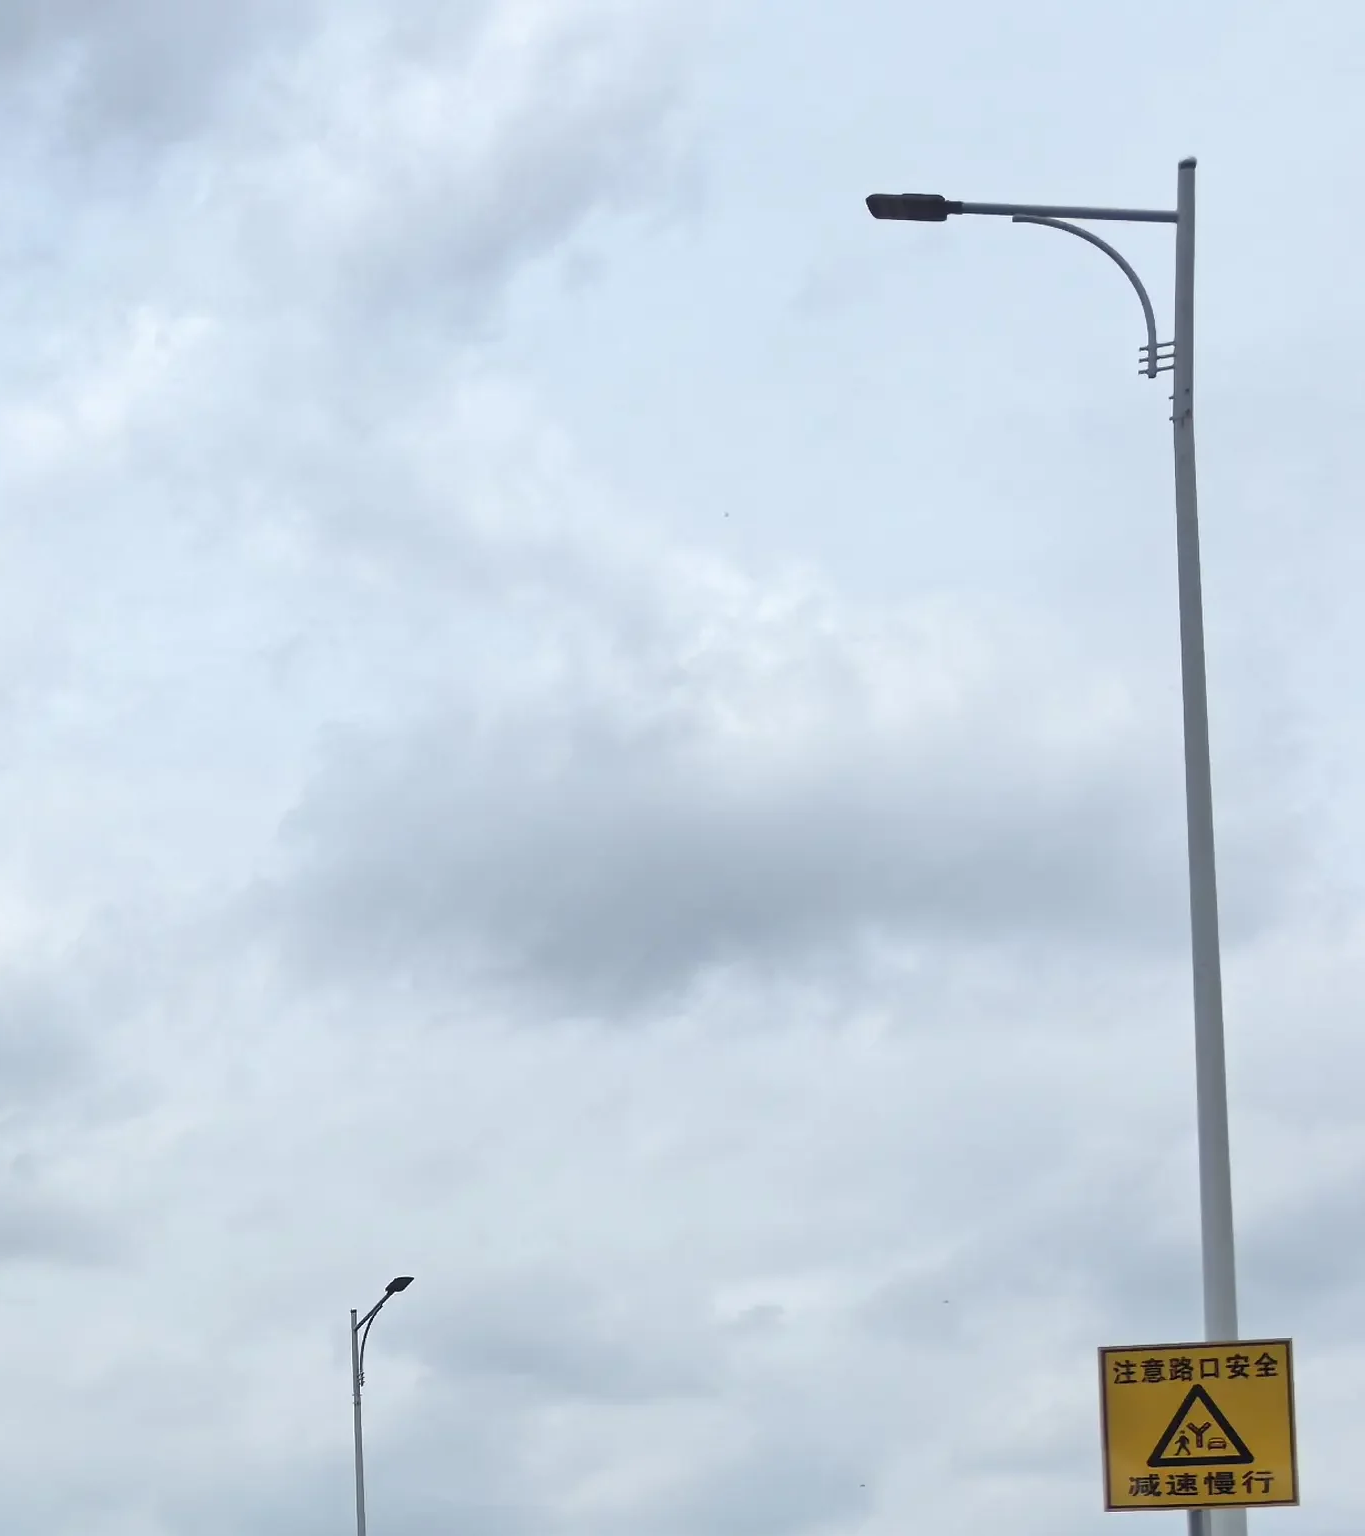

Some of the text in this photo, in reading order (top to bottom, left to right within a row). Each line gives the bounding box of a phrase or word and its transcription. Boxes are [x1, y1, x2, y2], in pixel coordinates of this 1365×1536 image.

[1113, 1352, 1279, 1384] 注意路口安全
[1128, 1470, 1275, 1497] 减速慢行
